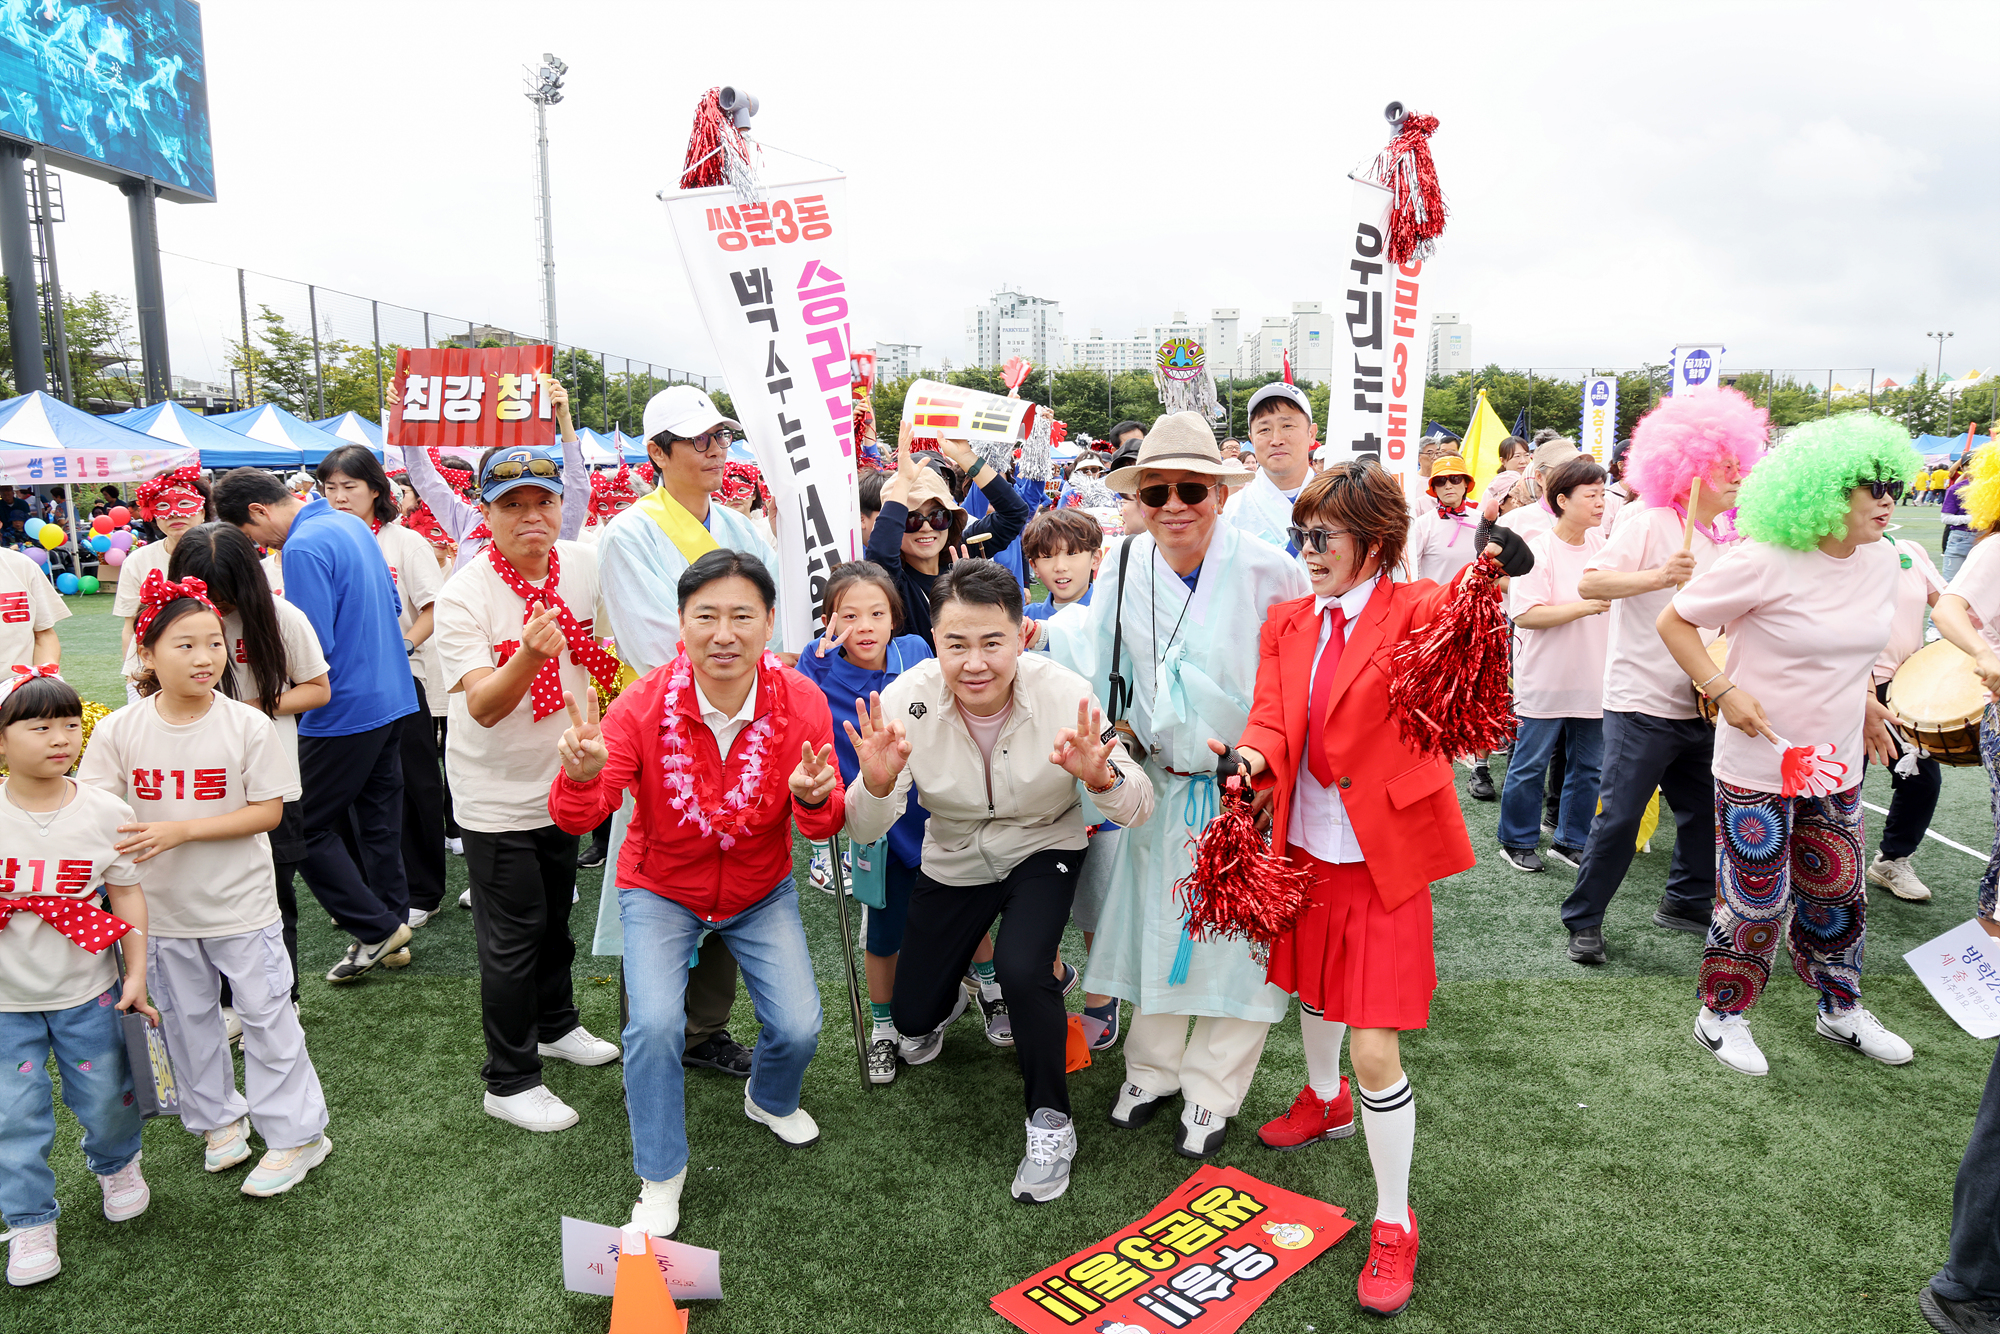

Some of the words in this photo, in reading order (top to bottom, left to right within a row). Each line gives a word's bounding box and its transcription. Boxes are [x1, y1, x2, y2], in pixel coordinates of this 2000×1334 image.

[706, 194, 833, 252] 쌍문3동
[1346, 222, 1384, 414] 우리는
[1387, 259, 1422, 460] 문3동
[1685, 358, 1711, 369] 끝까지
[1689, 368, 1706, 379] 함께
[402, 374, 486, 422] 최강
[132, 767, 228, 801] 창1동
[1940, 953, 1956, 967] 세
[587, 1261, 604, 1276] 세
